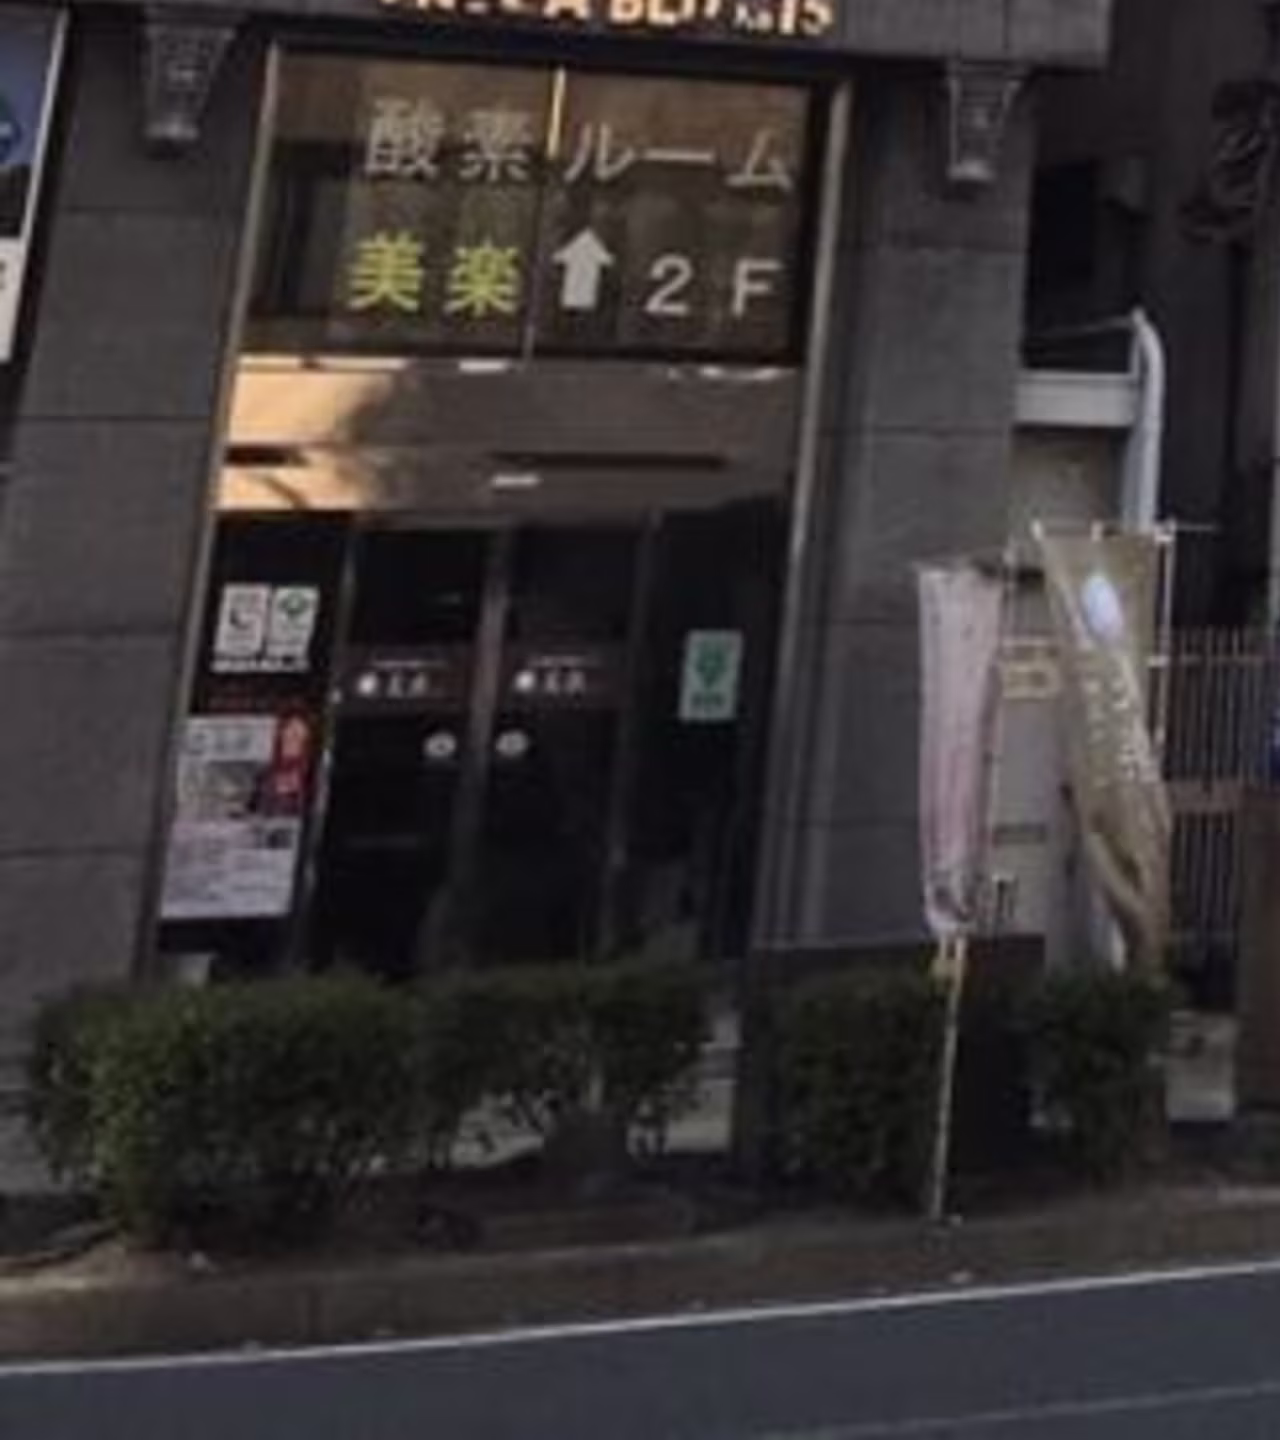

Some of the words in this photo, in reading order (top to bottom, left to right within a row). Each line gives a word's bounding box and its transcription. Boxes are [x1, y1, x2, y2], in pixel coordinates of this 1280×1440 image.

[365, 98, 794, 192] 酸素ルーム
[349, 231, 521, 317] 美楽
[645, 254, 784, 319] 2F
